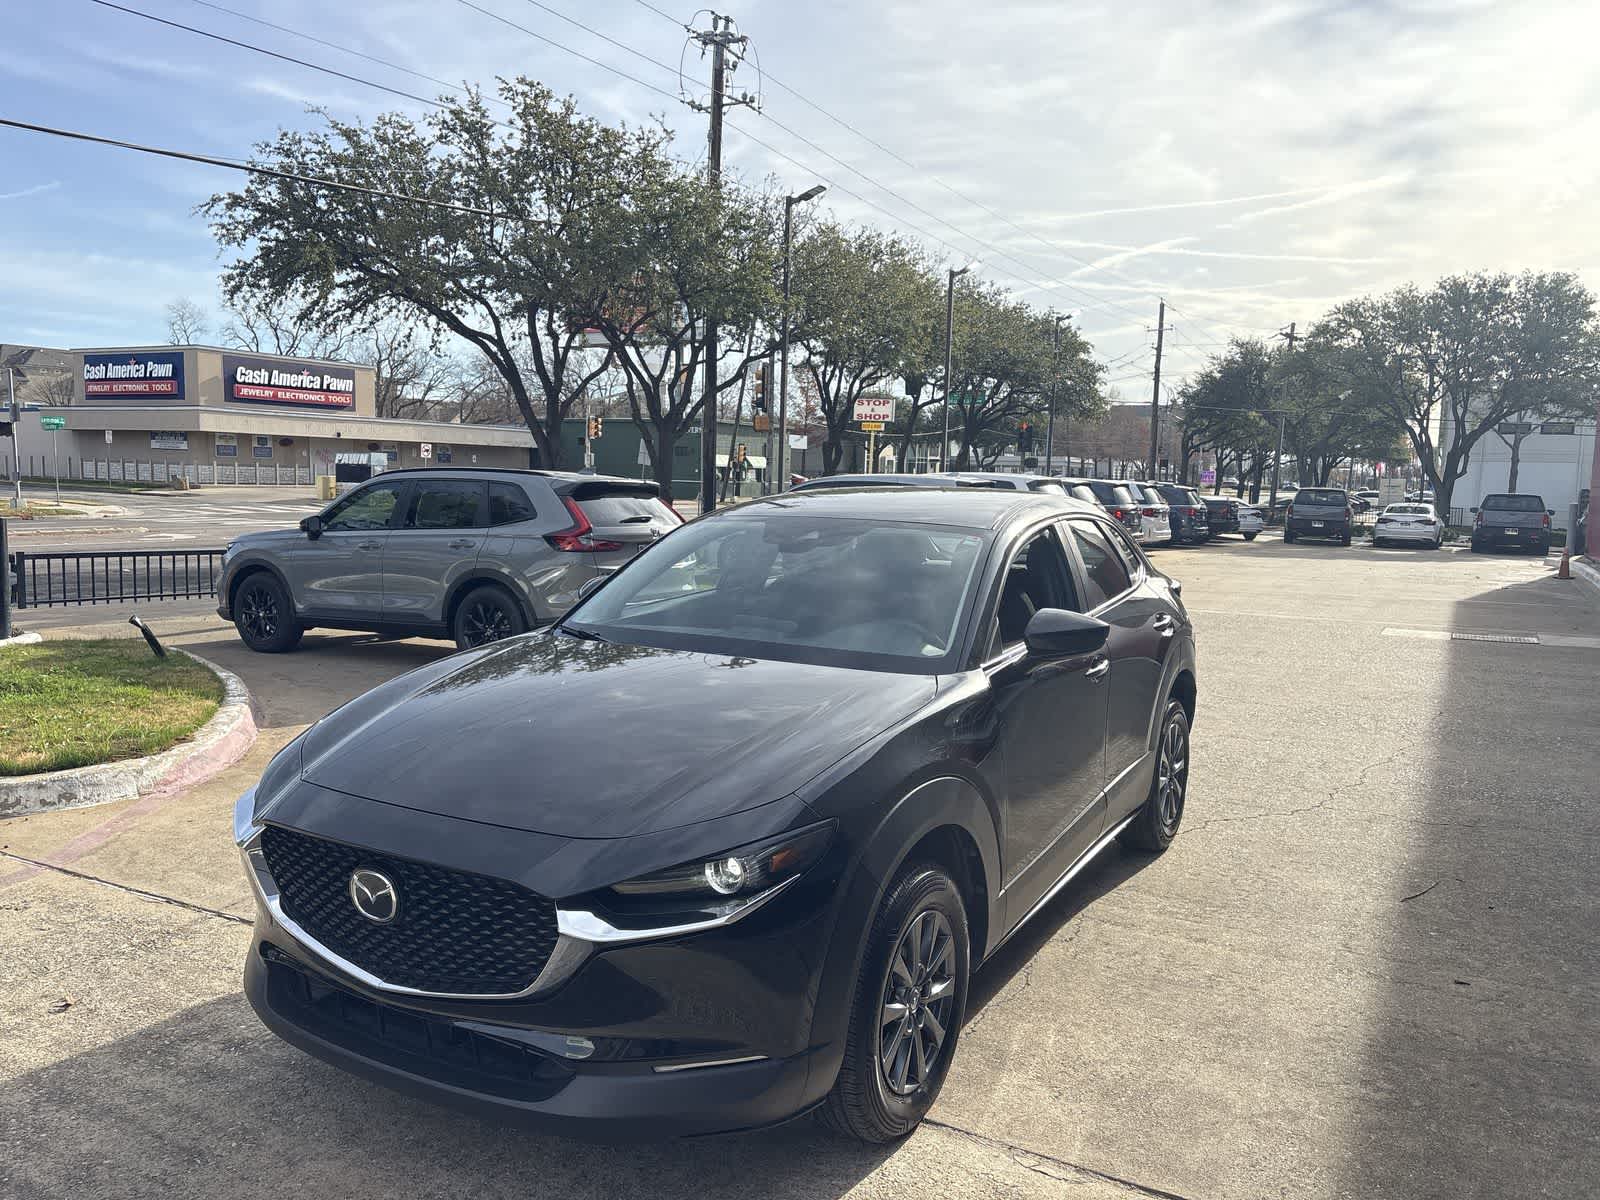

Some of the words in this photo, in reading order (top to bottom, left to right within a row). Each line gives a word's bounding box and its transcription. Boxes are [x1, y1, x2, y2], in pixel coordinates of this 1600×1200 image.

[84, 363, 106, 379] Cash
[107, 362, 145, 378] America
[146, 361, 173, 377] Pawn
[236, 366, 269, 384] Cash
[270, 369, 321, 389] America
[322, 374, 353, 392] Pawn
[87, 384, 110, 392] JEWELRY
[112, 384, 149, 392] ELECTRONICS
[151, 383, 172, 391] TOOLS
[239, 387, 274, 397] JEWELRY
[277, 391, 325, 402] ELECTRONICS
[327, 395, 350, 403] TOOLS
[335, 453, 369, 465] PAWN
